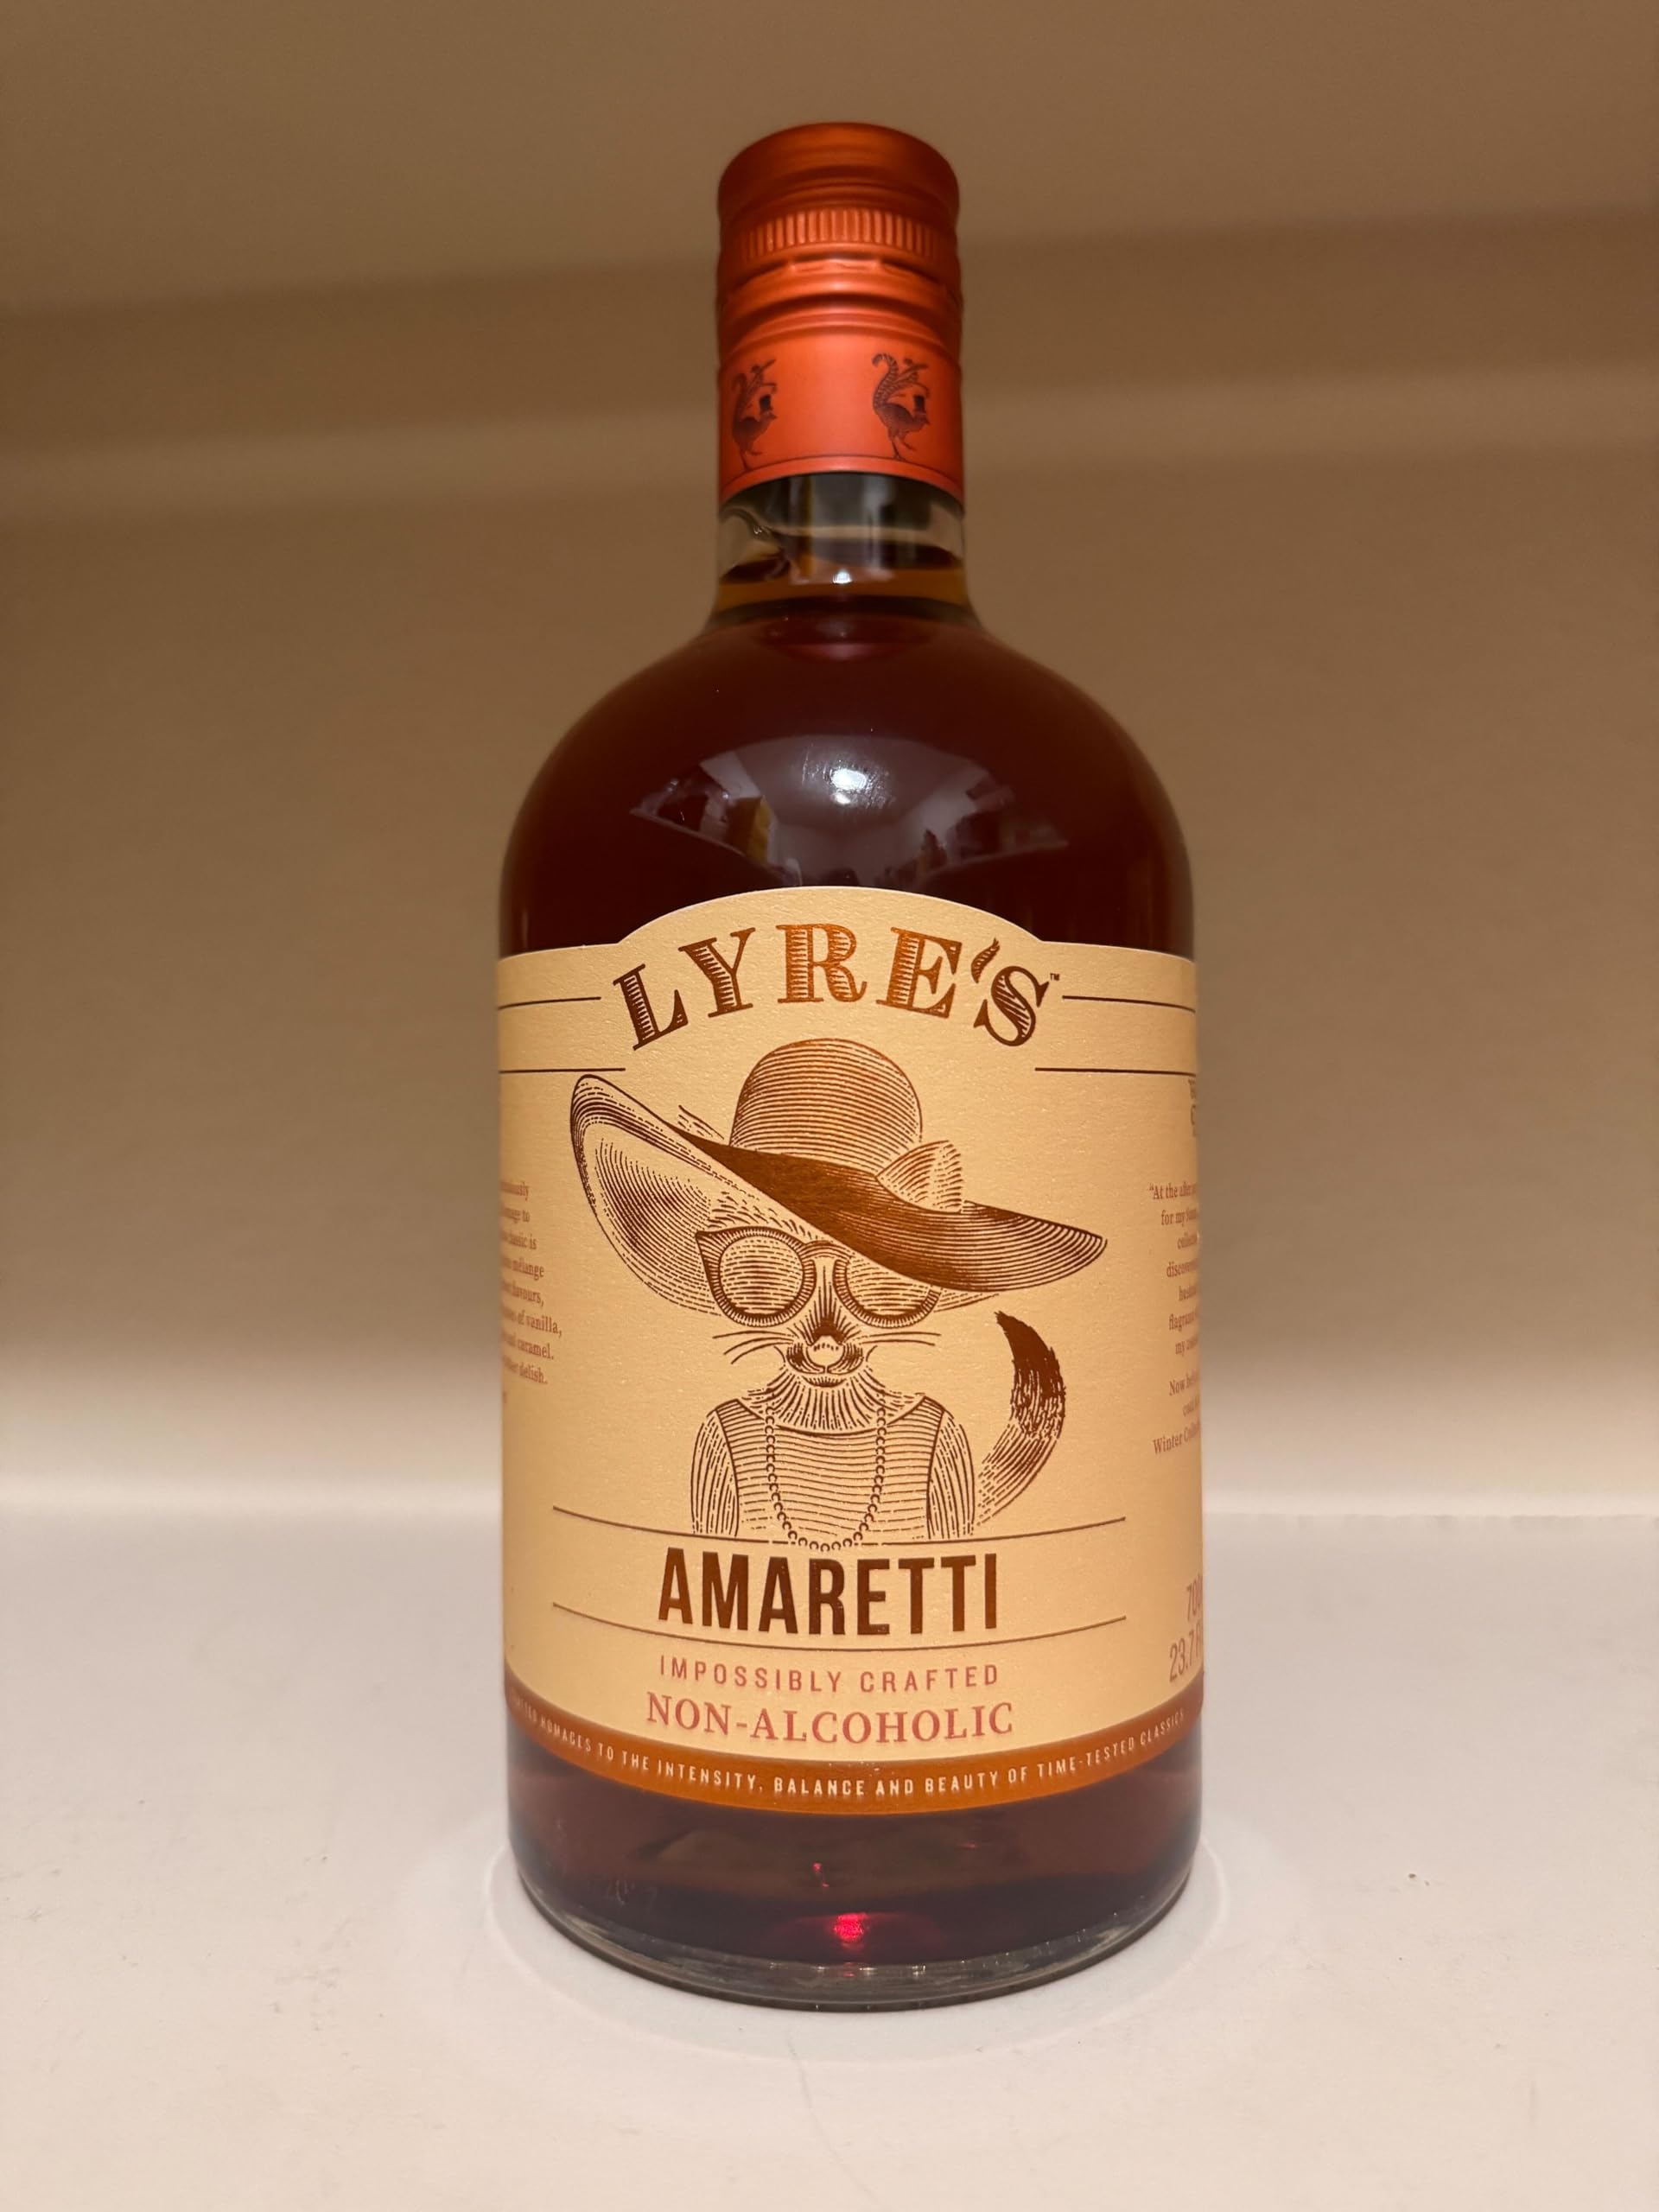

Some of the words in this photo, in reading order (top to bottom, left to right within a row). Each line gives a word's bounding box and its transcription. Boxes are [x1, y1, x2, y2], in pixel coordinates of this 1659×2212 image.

[613, 923, 1049, 1051] LYRE'S
[518, 1338, 554, 1360] caramel.
[526, 1314, 563, 1338] vanilla,
[1153, 1432, 1183, 1455] Winter
[658, 1547, 997, 1636] AMARETTI
[660, 1654, 842, 1693] IMPOSSIBLY
[861, 1664, 998, 1693] CRAFTED
[646, 1691, 1014, 1744] NON-ALCOHOLIC
[597, 1742, 614, 1761] TO
[622, 1751, 649, 1771] THE
[658, 1759, 763, 1791] INTENSITY,
[774, 1777, 865, 1796] BALANCE
[875, 1779, 913, 1796] AND
[925, 1771, 998, 1794] BEAUTY
[1008, 1767, 1027, 1784] OF
[1037, 1737, 1135, 1778] TIME-TESTED
[1140, 1707, 1185, 1746] CLASSICS
